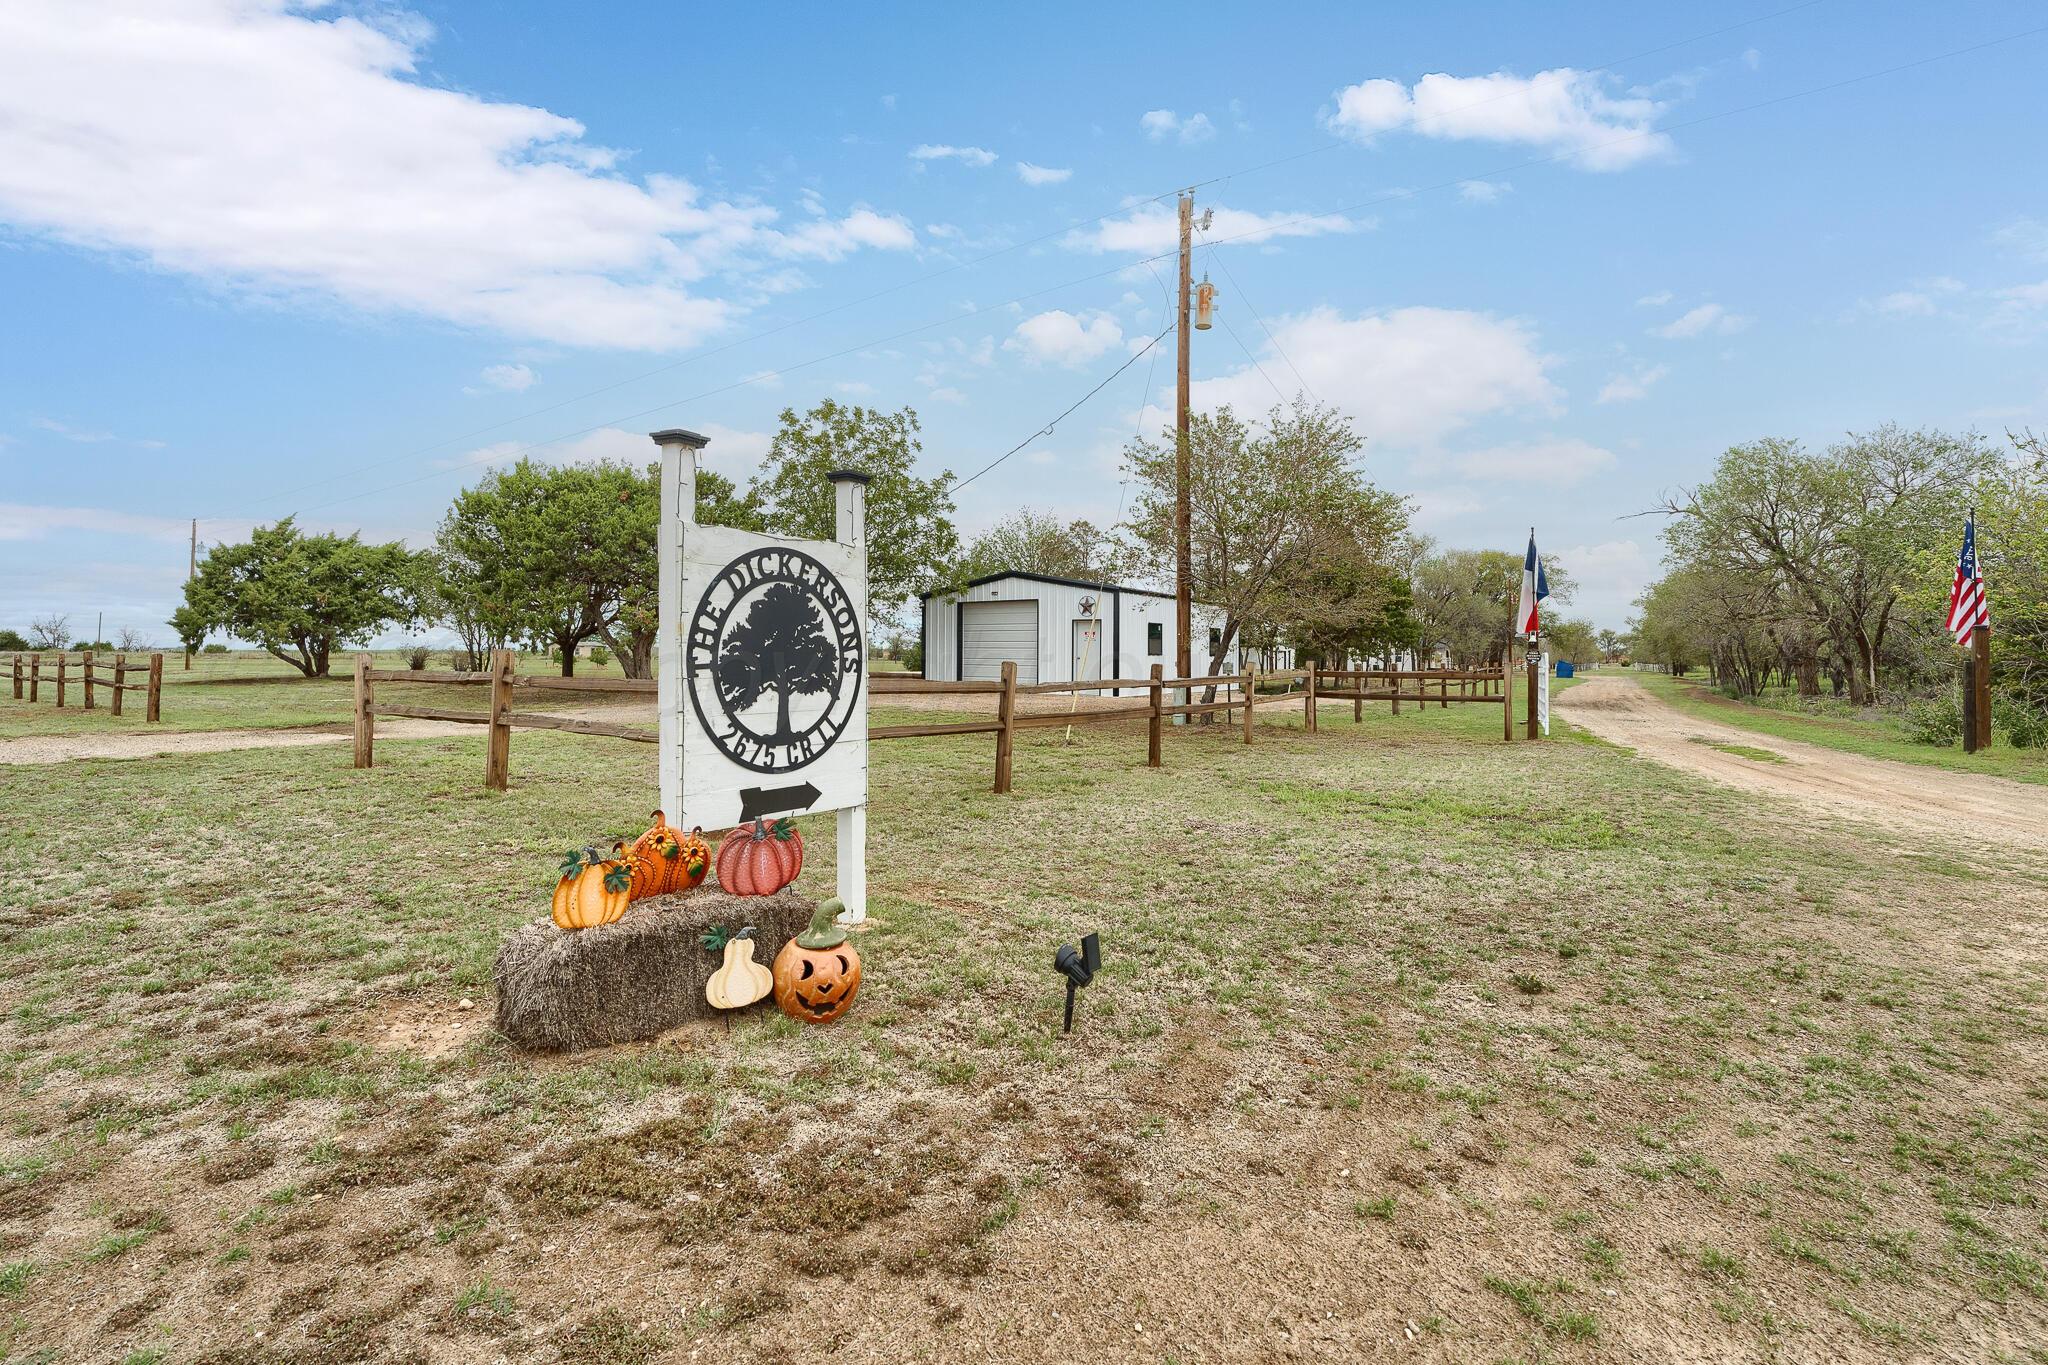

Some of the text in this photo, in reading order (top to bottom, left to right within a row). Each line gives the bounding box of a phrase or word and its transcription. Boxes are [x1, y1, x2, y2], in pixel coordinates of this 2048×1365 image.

[693, 600, 724, 677] THE
[725, 553, 859, 674] DICKERSONS
[719, 722, 775, 767] 2675
[786, 737, 814, 764] CR
